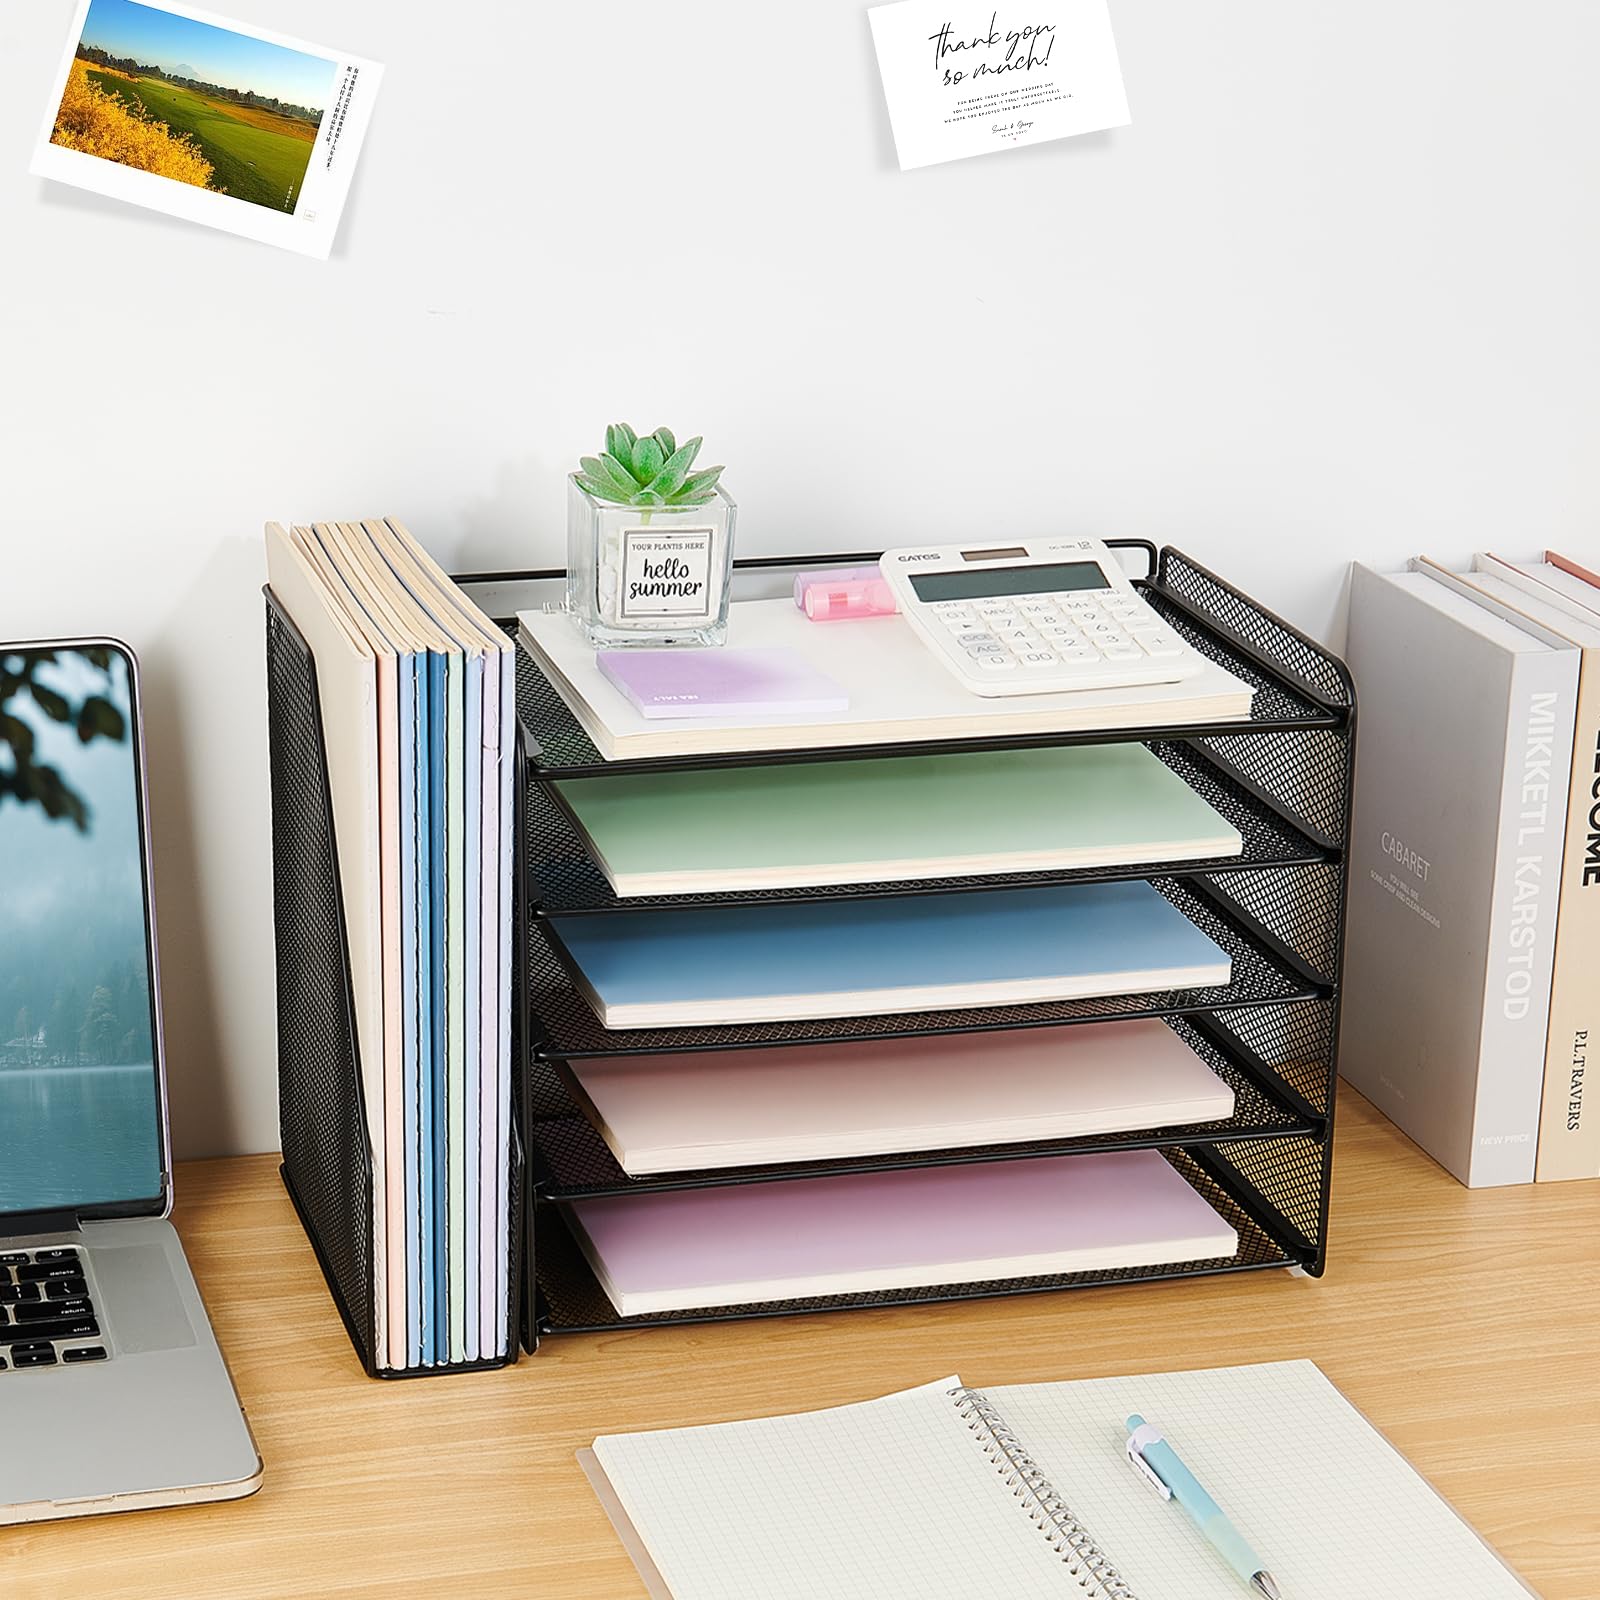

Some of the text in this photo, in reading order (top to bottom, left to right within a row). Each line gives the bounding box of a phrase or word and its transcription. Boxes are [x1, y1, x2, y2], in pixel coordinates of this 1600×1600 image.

[928, 11, 1056, 70] thank you
[942, 34, 1055, 86] so much!
[632, 543, 653, 551] YOUR
[685, 541, 705, 550] HERE
[643, 558, 690, 579] hello
[629, 581, 703, 600] summer
[1043, 615, 1057, 624] 8
[1381, 831, 1431, 881] CABARET
[1503, 691, 1559, 1021] MIKKETL KARSTOD
[1567, 1030, 1588, 1131] P.L.TRAVERS
